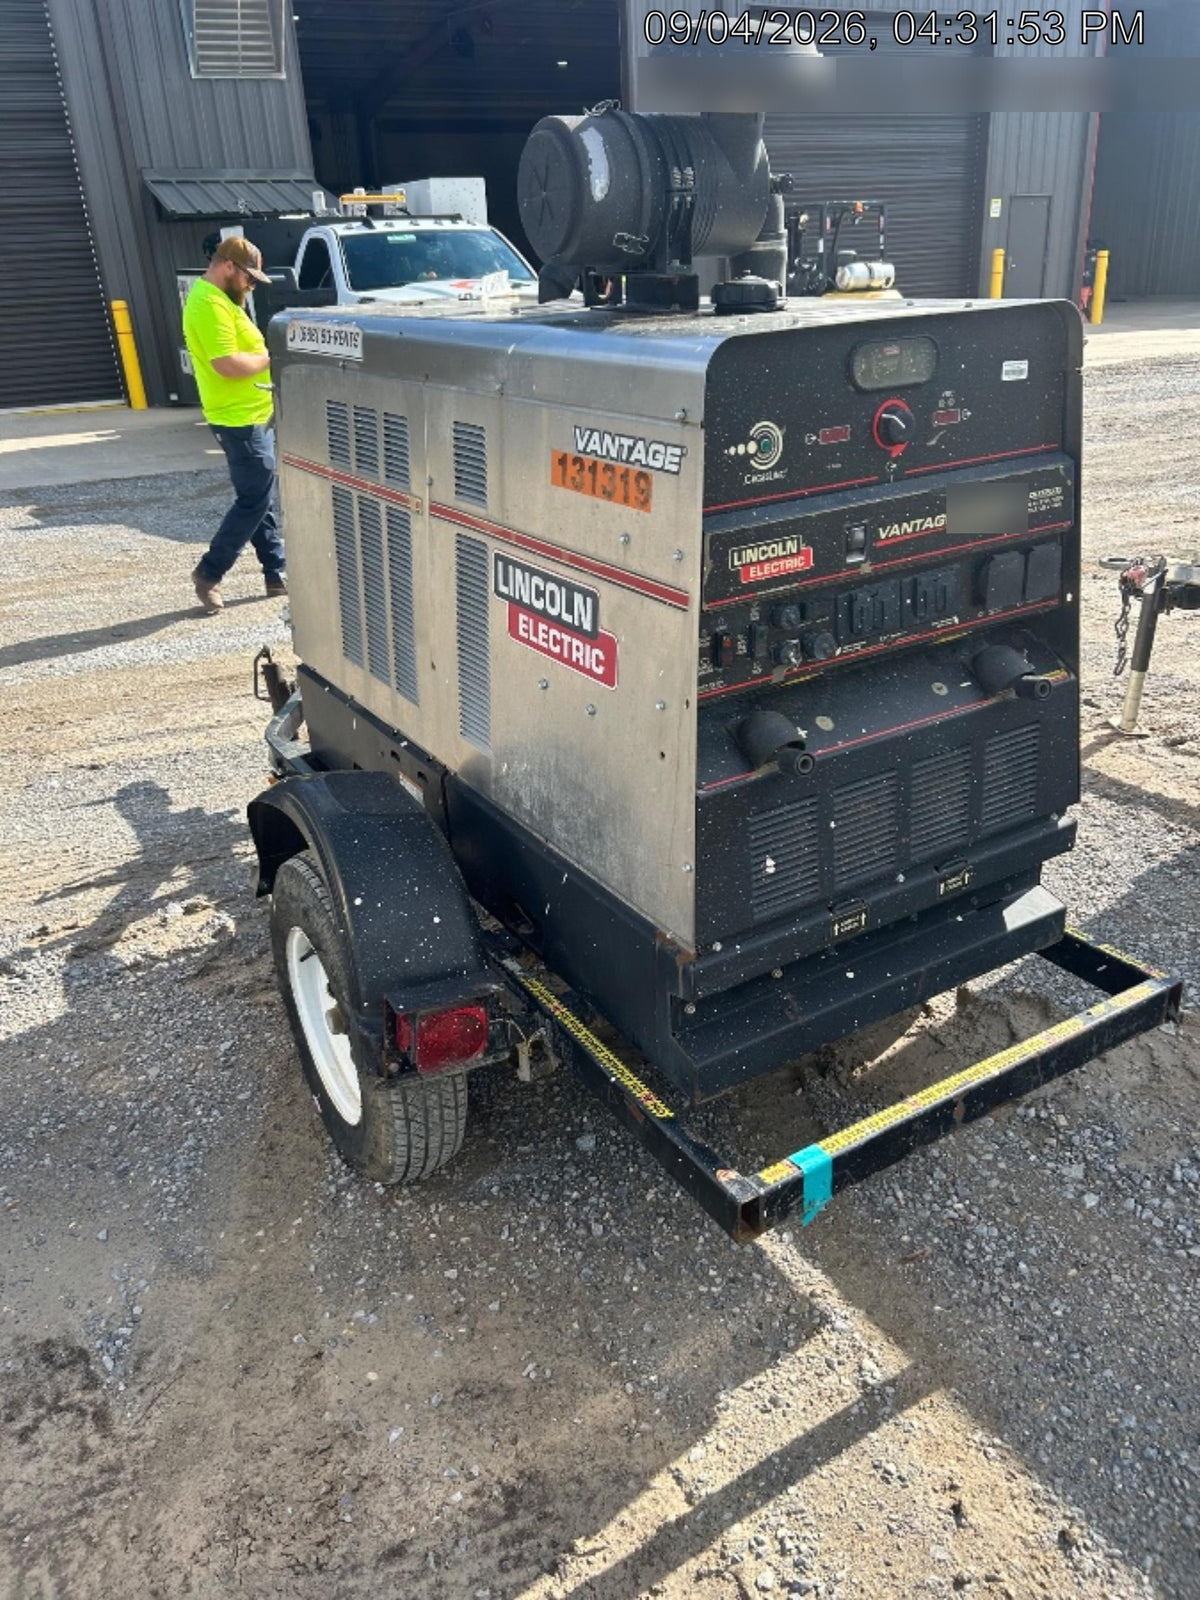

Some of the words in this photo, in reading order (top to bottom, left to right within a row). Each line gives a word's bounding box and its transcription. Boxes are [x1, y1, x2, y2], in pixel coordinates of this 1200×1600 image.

[574, 426, 683, 473] VANTAGE
[557, 453, 652, 508] 131319
[878, 514, 947, 540] VANTAG
[733, 539, 797, 566] LINCOLN
[749, 556, 805, 578] ELECTRIC
[497, 560, 593, 632] LINCOLN
[518, 613, 606, 675] ELECTRIC
